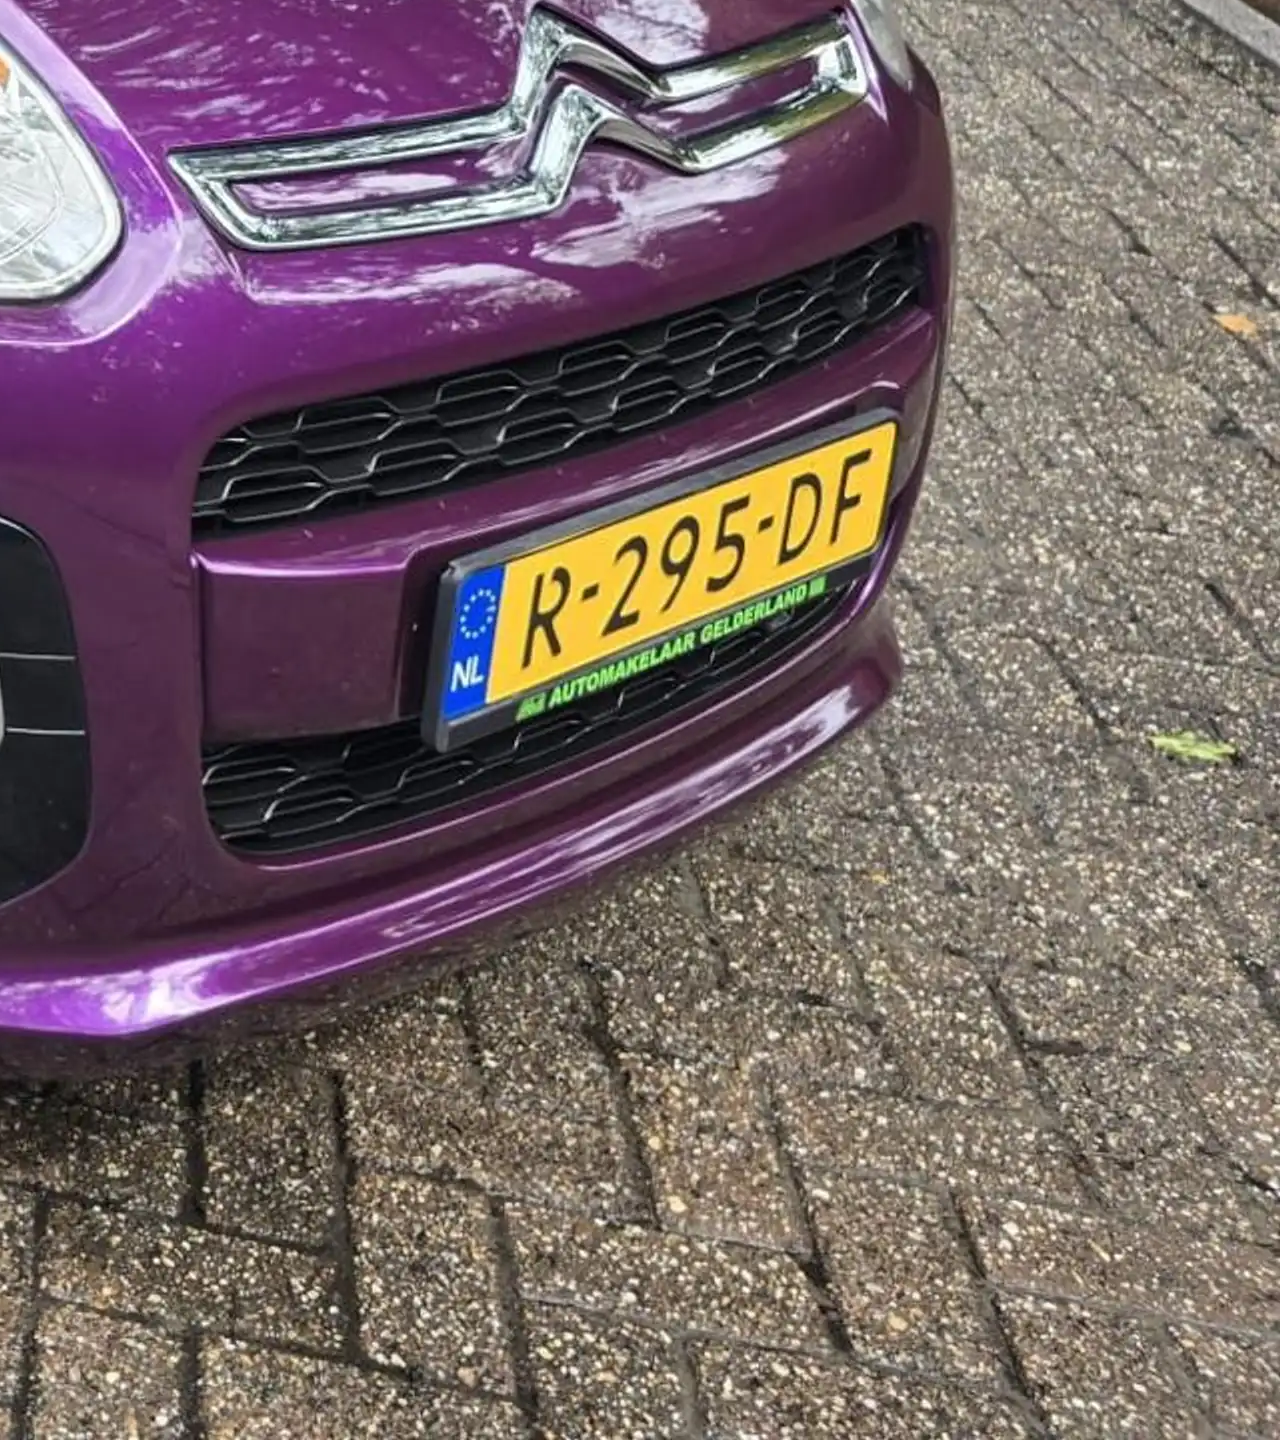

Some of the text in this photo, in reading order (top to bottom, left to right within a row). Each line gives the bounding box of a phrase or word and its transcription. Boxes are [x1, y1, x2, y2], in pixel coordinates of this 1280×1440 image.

[521, 448, 872, 670] R-295-DF
[450, 655, 484, 693] NL
[547, 631, 696, 710] AUTOMAKELAAR
[700, 583, 808, 644] GELDERLAND
